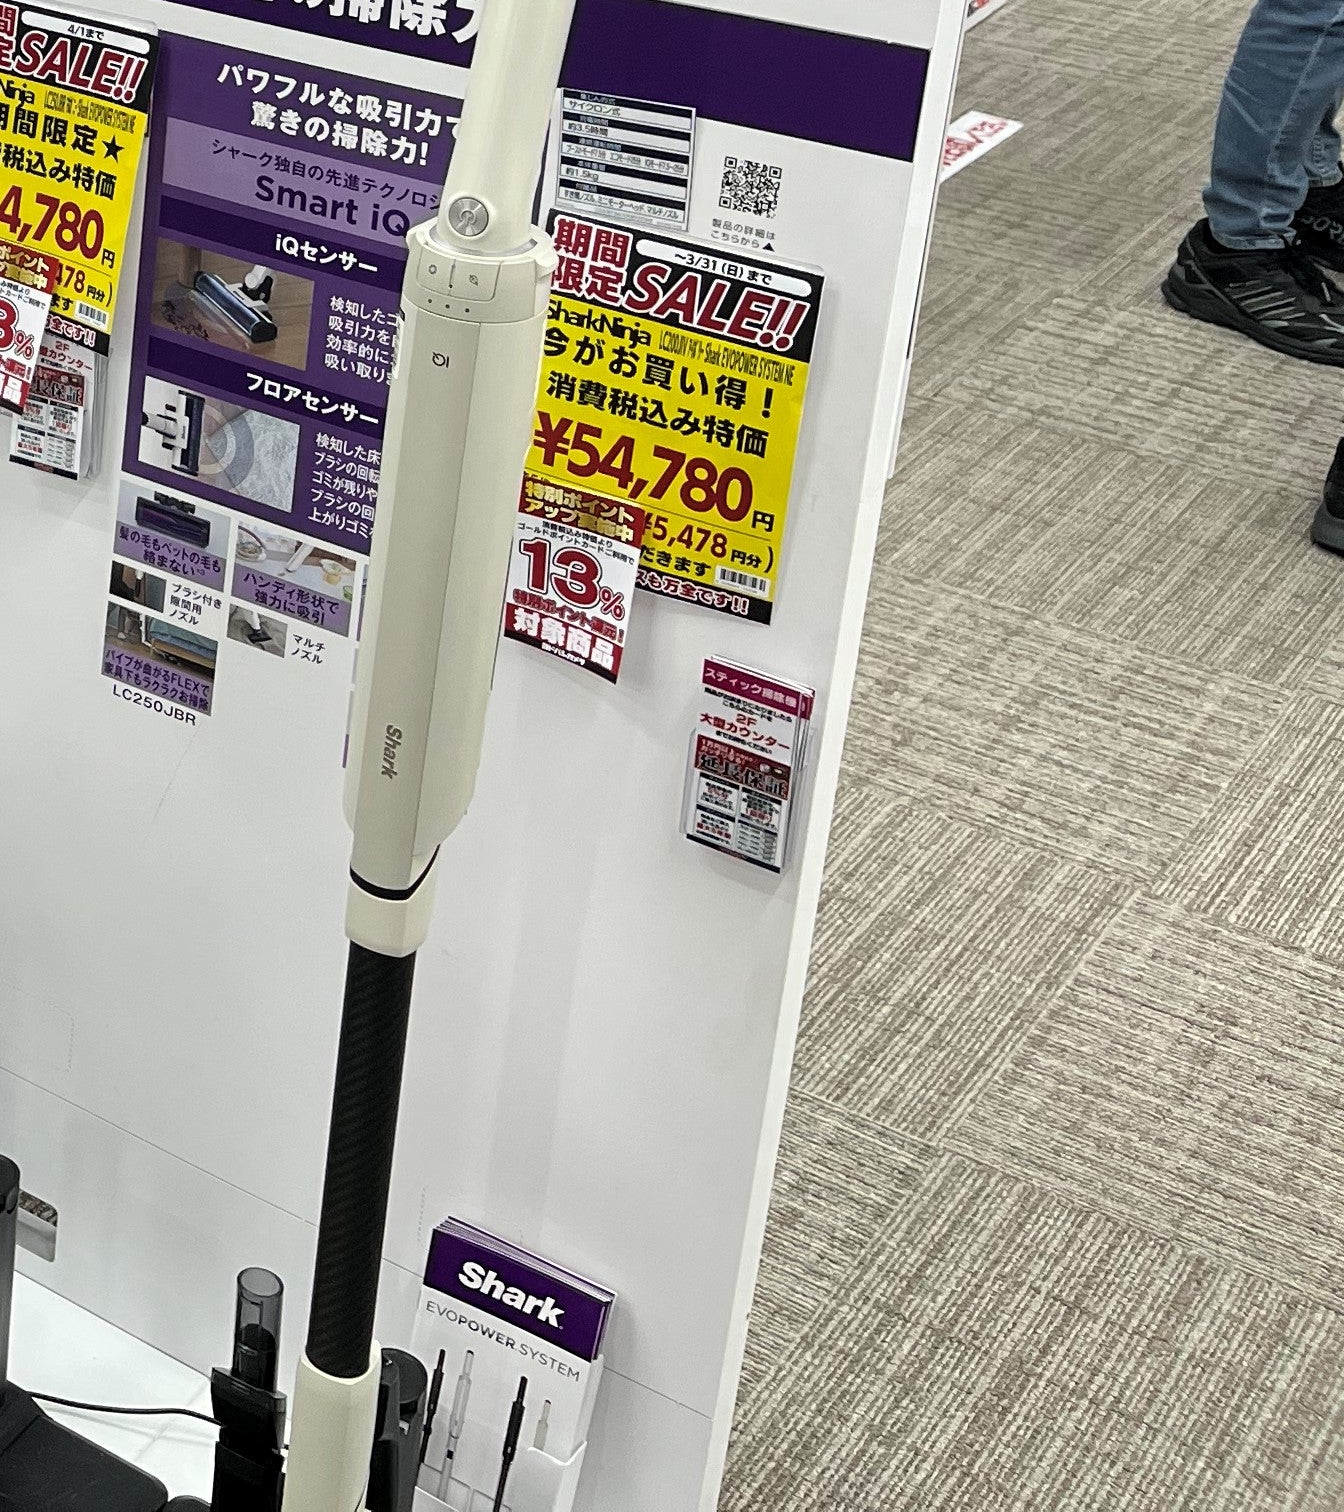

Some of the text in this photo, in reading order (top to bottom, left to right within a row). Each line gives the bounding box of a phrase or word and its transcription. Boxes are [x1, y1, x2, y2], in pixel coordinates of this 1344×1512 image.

[66, 22, 105, 41] 4/1まで
[12, 29, 148, 104] SALE!!
[567, 122, 609, 138] 約3.5時間
[568, 99, 622, 118] サイクロン式
[249, 99, 429, 167] 驚きの掃除力!
[564, 166, 600, 183] 約1.5kg
[254, 174, 411, 240] Smart iQ
[711, 217, 777, 240] 製品の詳細は
[274, 233, 380, 274] iQセンサー
[553, 218, 632, 269] 期間
[711, 229, 760, 248] こちらから
[551, 253, 626, 309] 限定
[746, 269, 773, 287] まで
[546, 299, 653, 349] SharkNinja
[630, 262, 812, 354] SALE!!
[245, 372, 380, 426] フロアセンサー
[541, 332, 776, 422] 今がお買い得!
[545, 369, 772, 460] 消費税込み特価
[118, 525, 223, 574] 髪の毛もペットの毛も
[170, 582, 223, 610] ブラシ付き
[243, 570, 341, 615] ハンディ形状で
[254, 588, 327, 627] 強力に吸引
[169, 607, 200, 627] ノズル
[289, 645, 324, 666] ノズル
[290, 631, 327, 653] マルチ
[512, 608, 615, 672] 対象商品
[111, 686, 198, 727] LC250JBR
[735, 712, 758, 727] 2F
[381, 723, 404, 780] Shark
[457, 1260, 566, 1331] Shark
[425, 1299, 581, 1383] EVOPOWER SYSTEM
